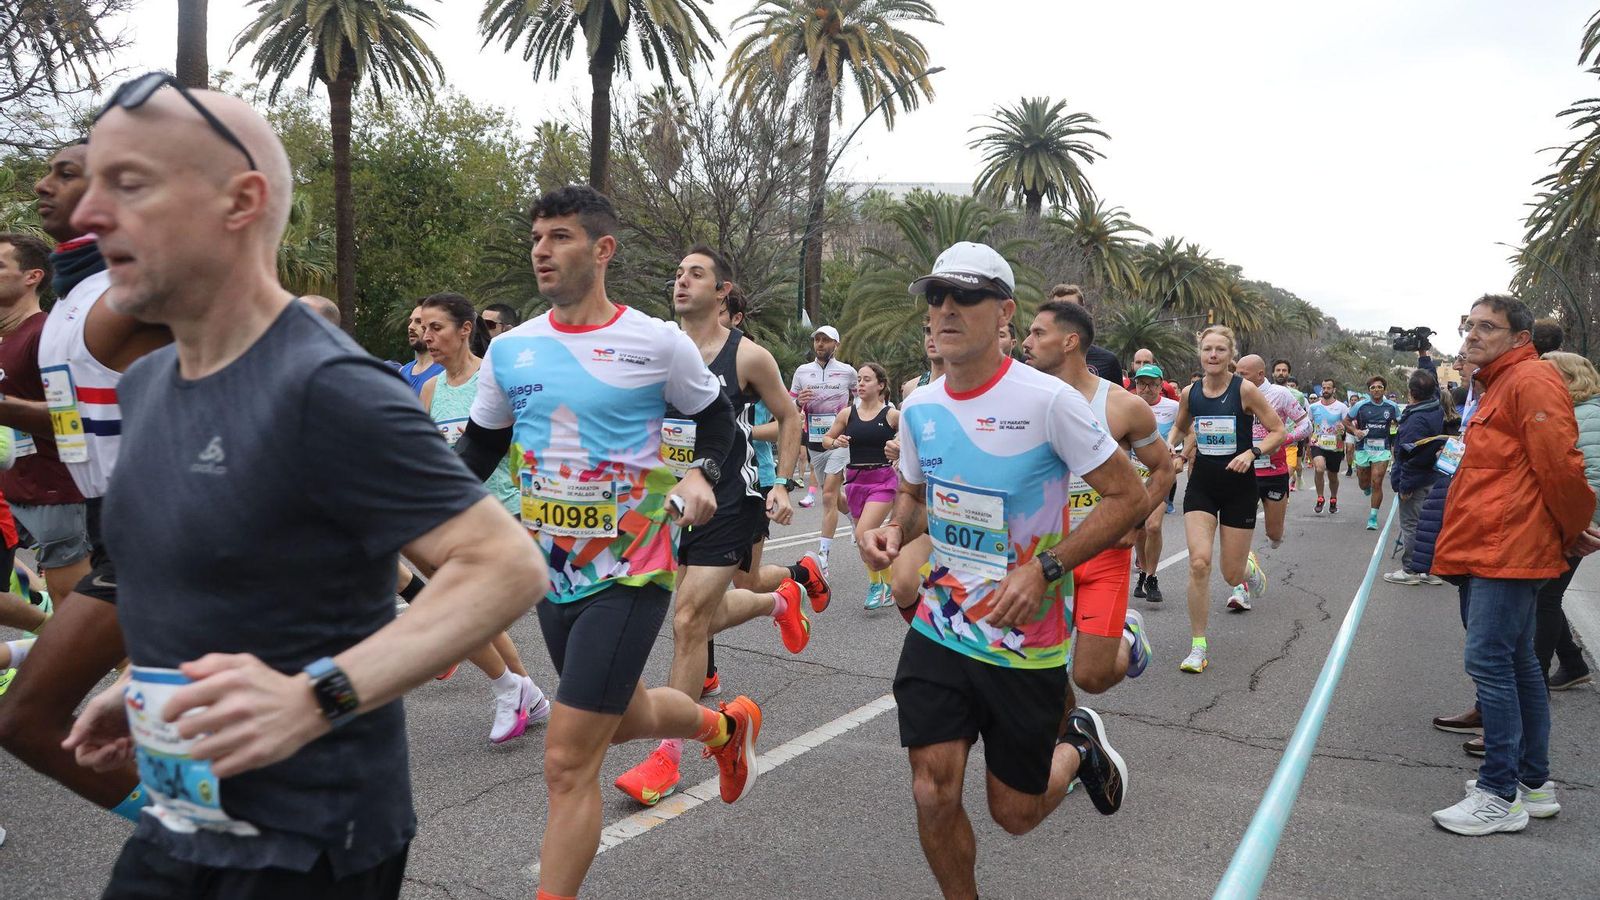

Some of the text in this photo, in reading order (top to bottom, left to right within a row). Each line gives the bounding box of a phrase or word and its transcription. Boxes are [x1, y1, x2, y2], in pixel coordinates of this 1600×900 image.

[508, 383, 543, 398] álaga
[1206, 435, 1225, 445] 584
[669, 447, 696, 464] 250
[920, 456, 943, 469] álaga
[1068, 493, 1094, 509] 73
[540, 502, 599, 529] 1098
[945, 524, 986, 552] 607
